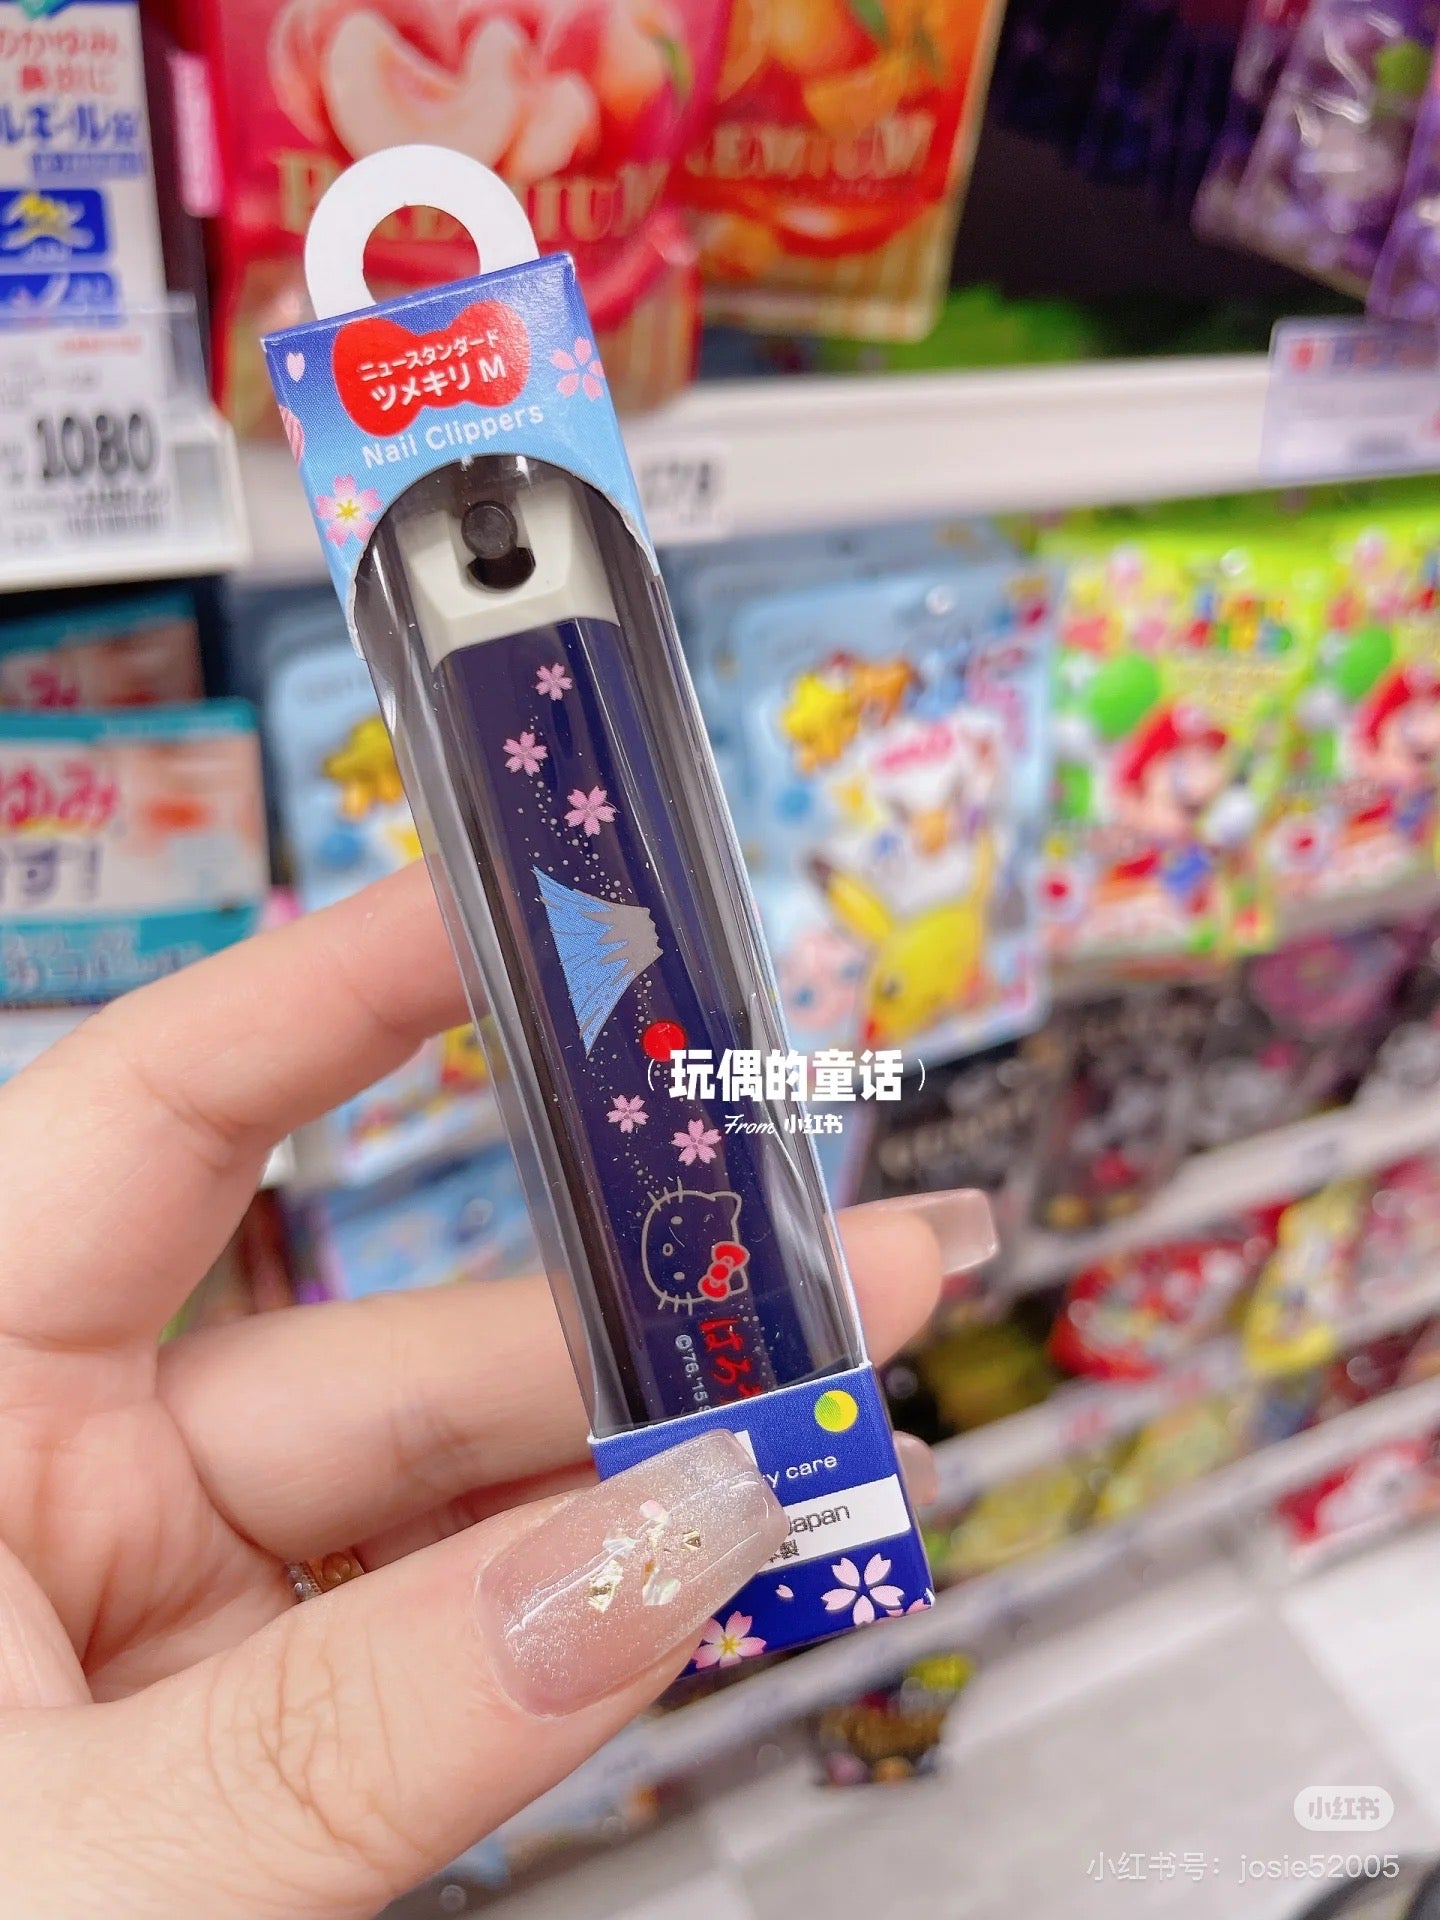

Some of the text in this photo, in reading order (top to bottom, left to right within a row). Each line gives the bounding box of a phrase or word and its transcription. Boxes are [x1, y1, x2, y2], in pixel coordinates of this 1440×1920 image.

[358, 329, 500, 382] ニュースタンダード
[371, 354, 507, 411] ツメキリ M
[36, 410, 160, 482] 1080
[362, 405, 544, 469] Nail Clippers
[786, 1455, 838, 1480] care
